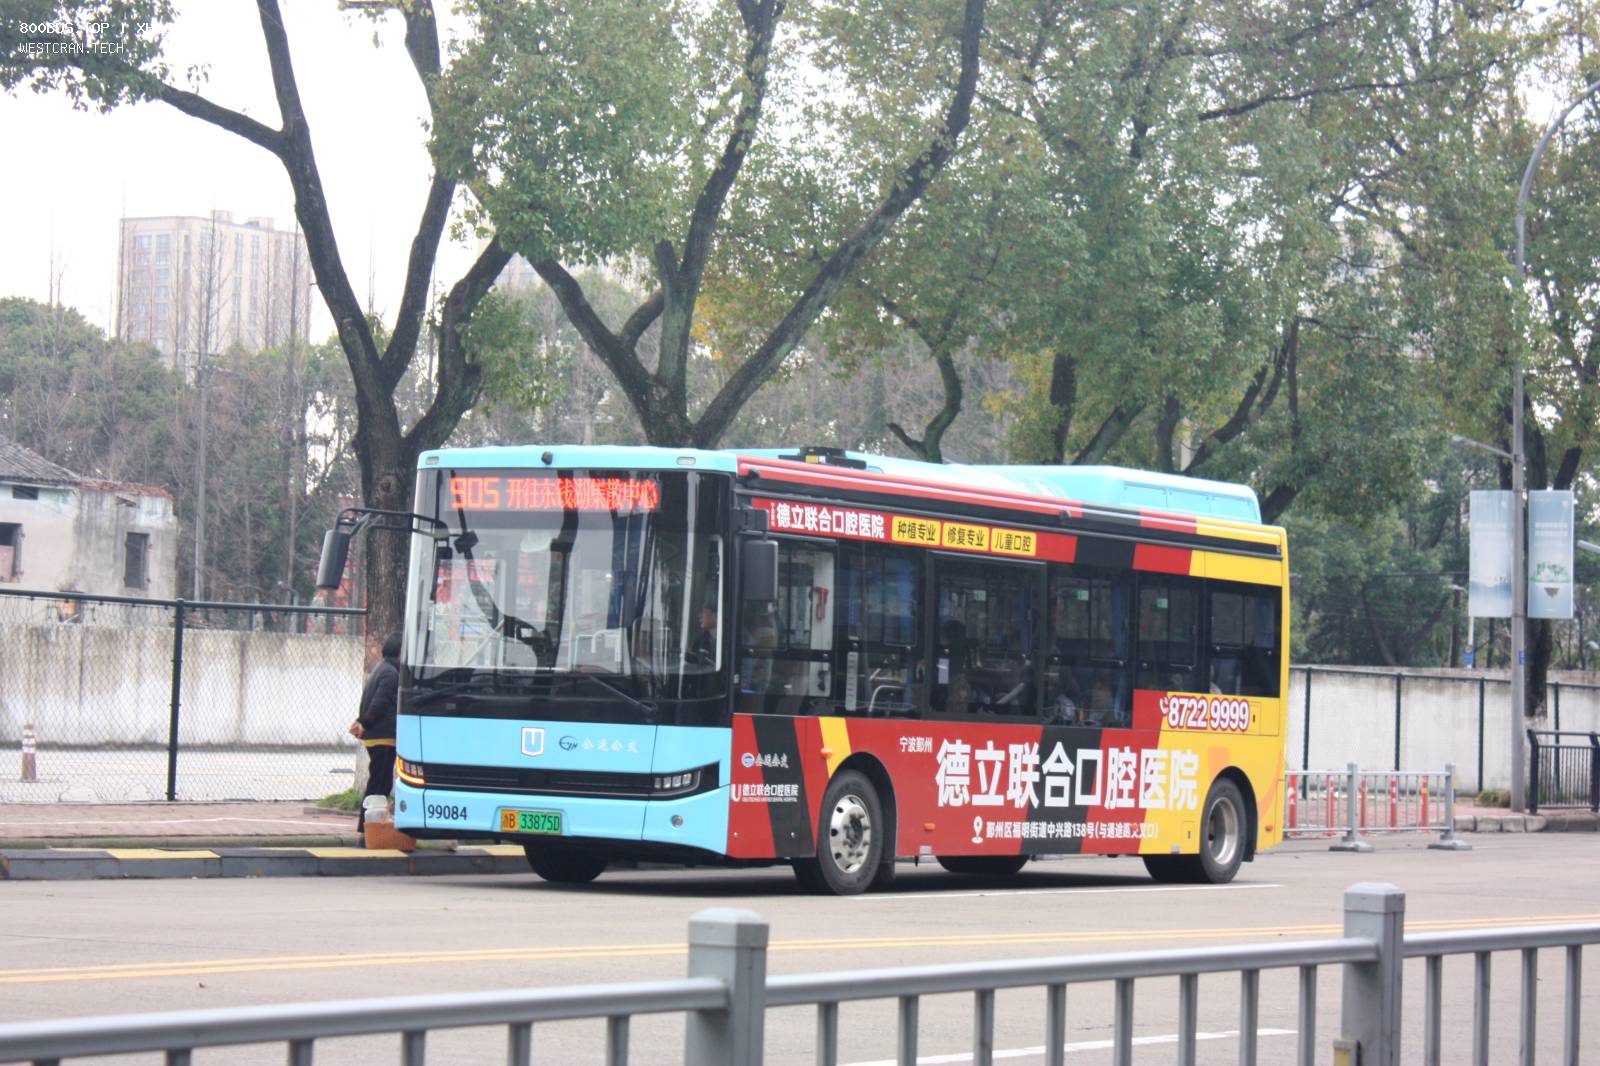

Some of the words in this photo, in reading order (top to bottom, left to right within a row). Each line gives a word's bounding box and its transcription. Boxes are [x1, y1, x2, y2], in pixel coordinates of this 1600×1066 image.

[451, 477, 500, 509] 905
[506, 478, 659, 510] 开往东钱湖集散中心
[776, 503, 885, 539] 德立联合口腔医院
[897, 520, 936, 541] 种植专业
[947, 527, 985, 547] 修复专业
[995, 531, 1032, 552] 儿童口腔
[899, 736, 933, 753] 宁波鄞州
[743, 783, 799, 796] 德立联合口腔医院
[935, 738, 1200, 811] 德立联合口腔医院
[427, 804, 468, 821] 99084
